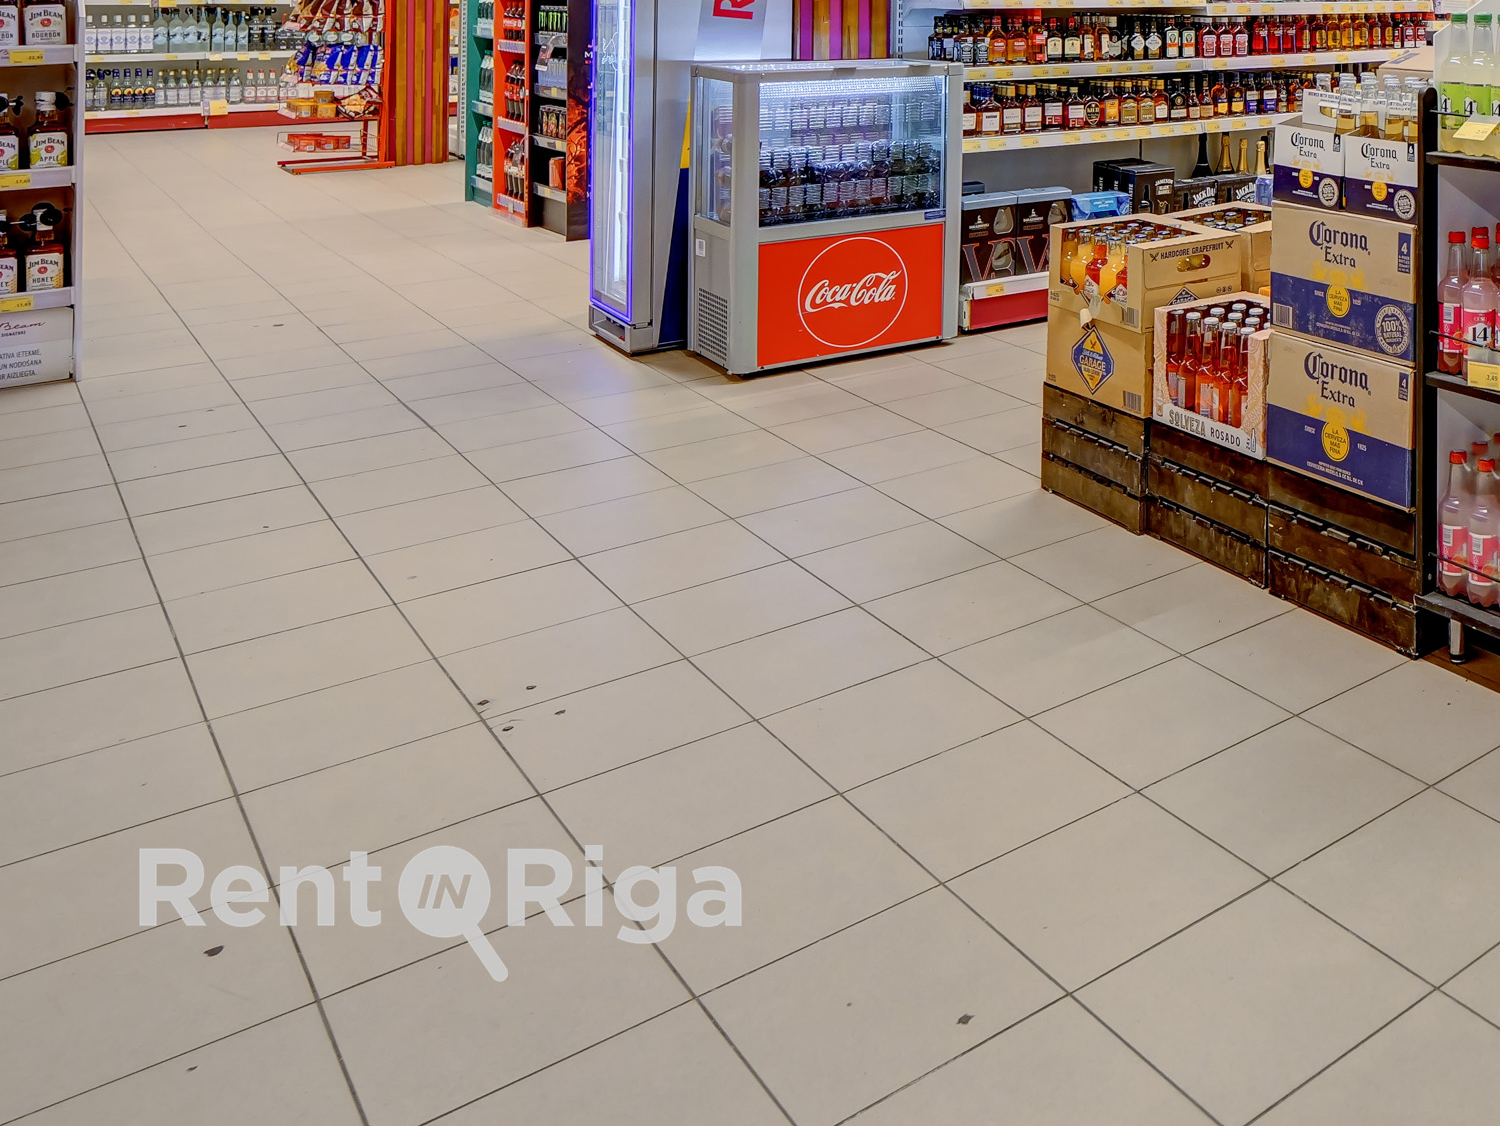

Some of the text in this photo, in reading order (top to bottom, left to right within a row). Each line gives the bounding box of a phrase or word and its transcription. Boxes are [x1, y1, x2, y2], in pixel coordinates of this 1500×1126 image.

[29, 9, 63, 21] JIM BEAM
[34, 137, 65, 148] JIM BEAM
[1291, 131, 1324, 149] Corona
[1299, 147, 1318, 158] Extra
[1361, 142, 1397, 160] Corona
[1370, 158, 1390, 169] Extra
[1309, 220, 1369, 252] Corona
[1160, 243, 1224, 260] HARDCORE GRAPEFRUIT
[1401, 242, 1408, 255] 4
[1324, 246, 1357, 268] Extra
[28, 258, 59, 269] JIM BEAM
[804, 270, 902, 312] Coca-Cola
[1329, 293, 1347, 302] CERVEZA
[1382, 320, 1402, 332] 100%
[1383, 330, 1402, 339] NATURAL
[1472, 327, 1489, 341] 14
[1079, 354, 1106, 371] GARAGE
[1304, 351, 1369, 391] Corona
[1401, 378, 1407, 387] 4
[1321, 380, 1356, 408] Extra
[1210, 427, 1241, 447] ROSADO
[1325, 432, 1346, 444] CERVEZA
[1329, 446, 1341, 455] FINA
[1357, 443, 1367, 451] 1925
